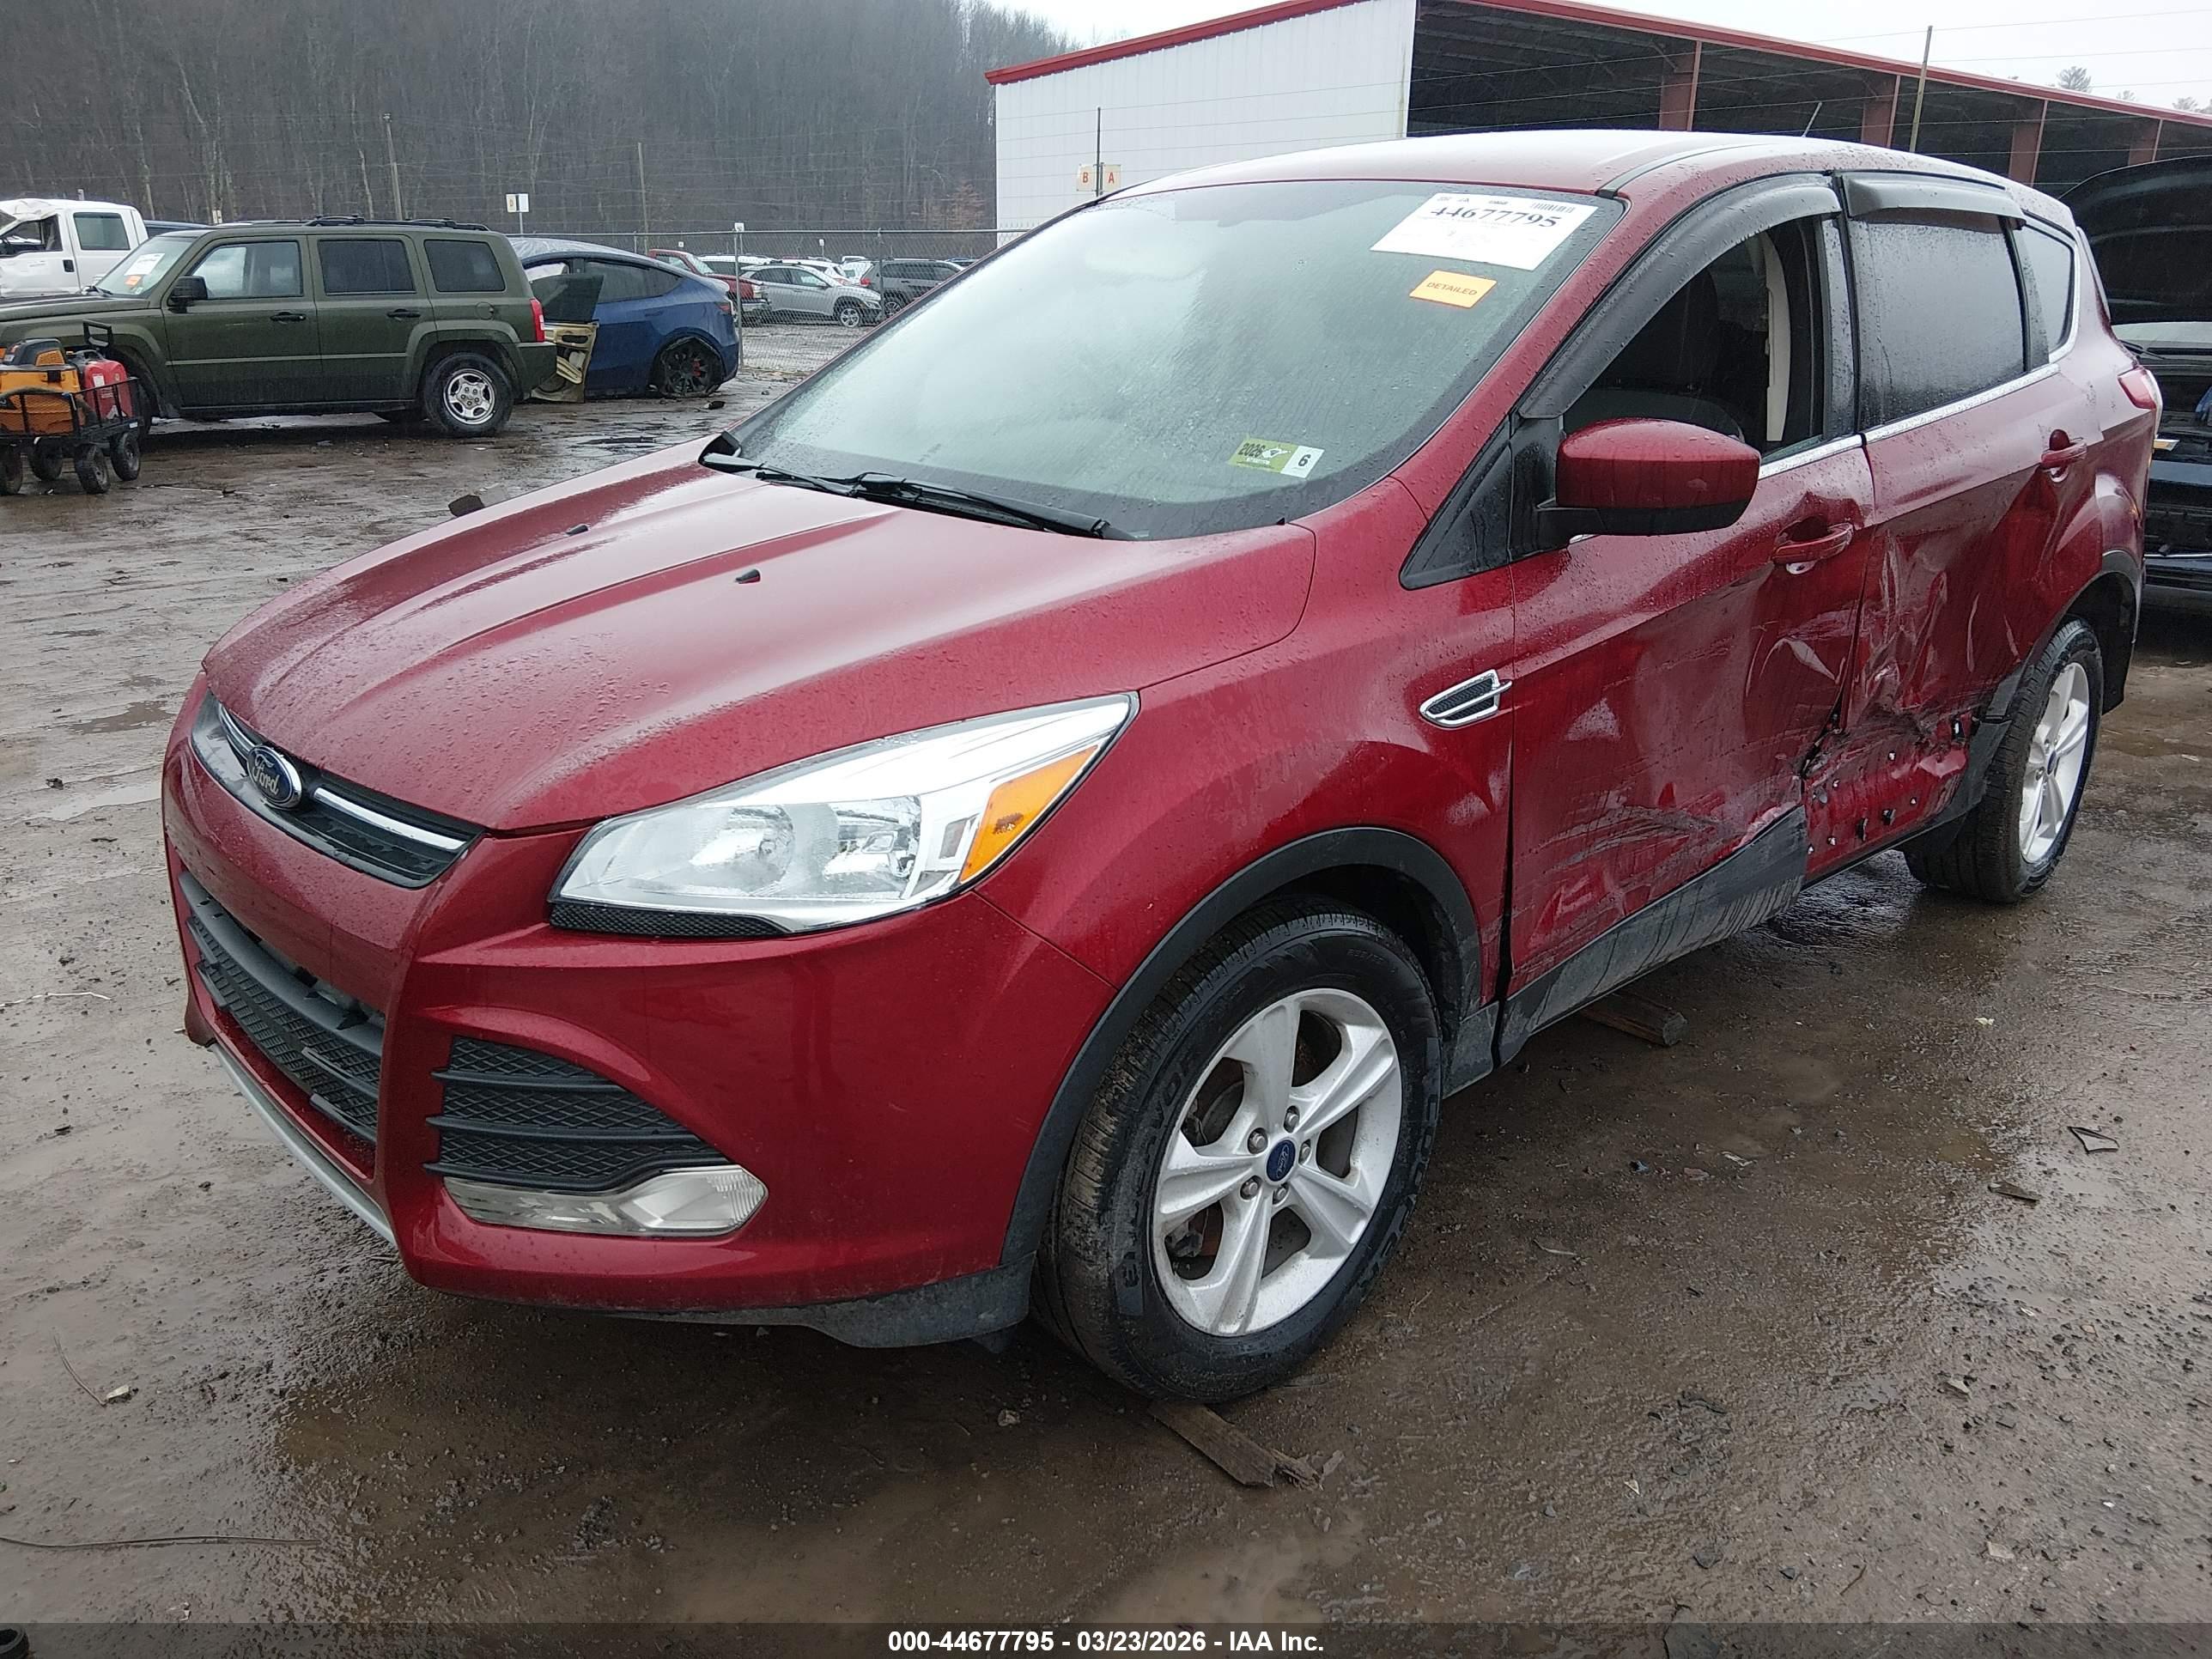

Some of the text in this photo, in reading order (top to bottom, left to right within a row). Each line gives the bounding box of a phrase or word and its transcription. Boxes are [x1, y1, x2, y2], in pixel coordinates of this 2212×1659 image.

[1083, 173, 1089, 184] B
[1109, 173, 1115, 184] A
[1430, 206, 1562, 228] 44677795
[1426, 282, 1479, 296] DETAILED
[1237, 442, 1267, 458] 2026
[1297, 454, 1311, 466] 6
[252, 754, 280, 795] Ford
